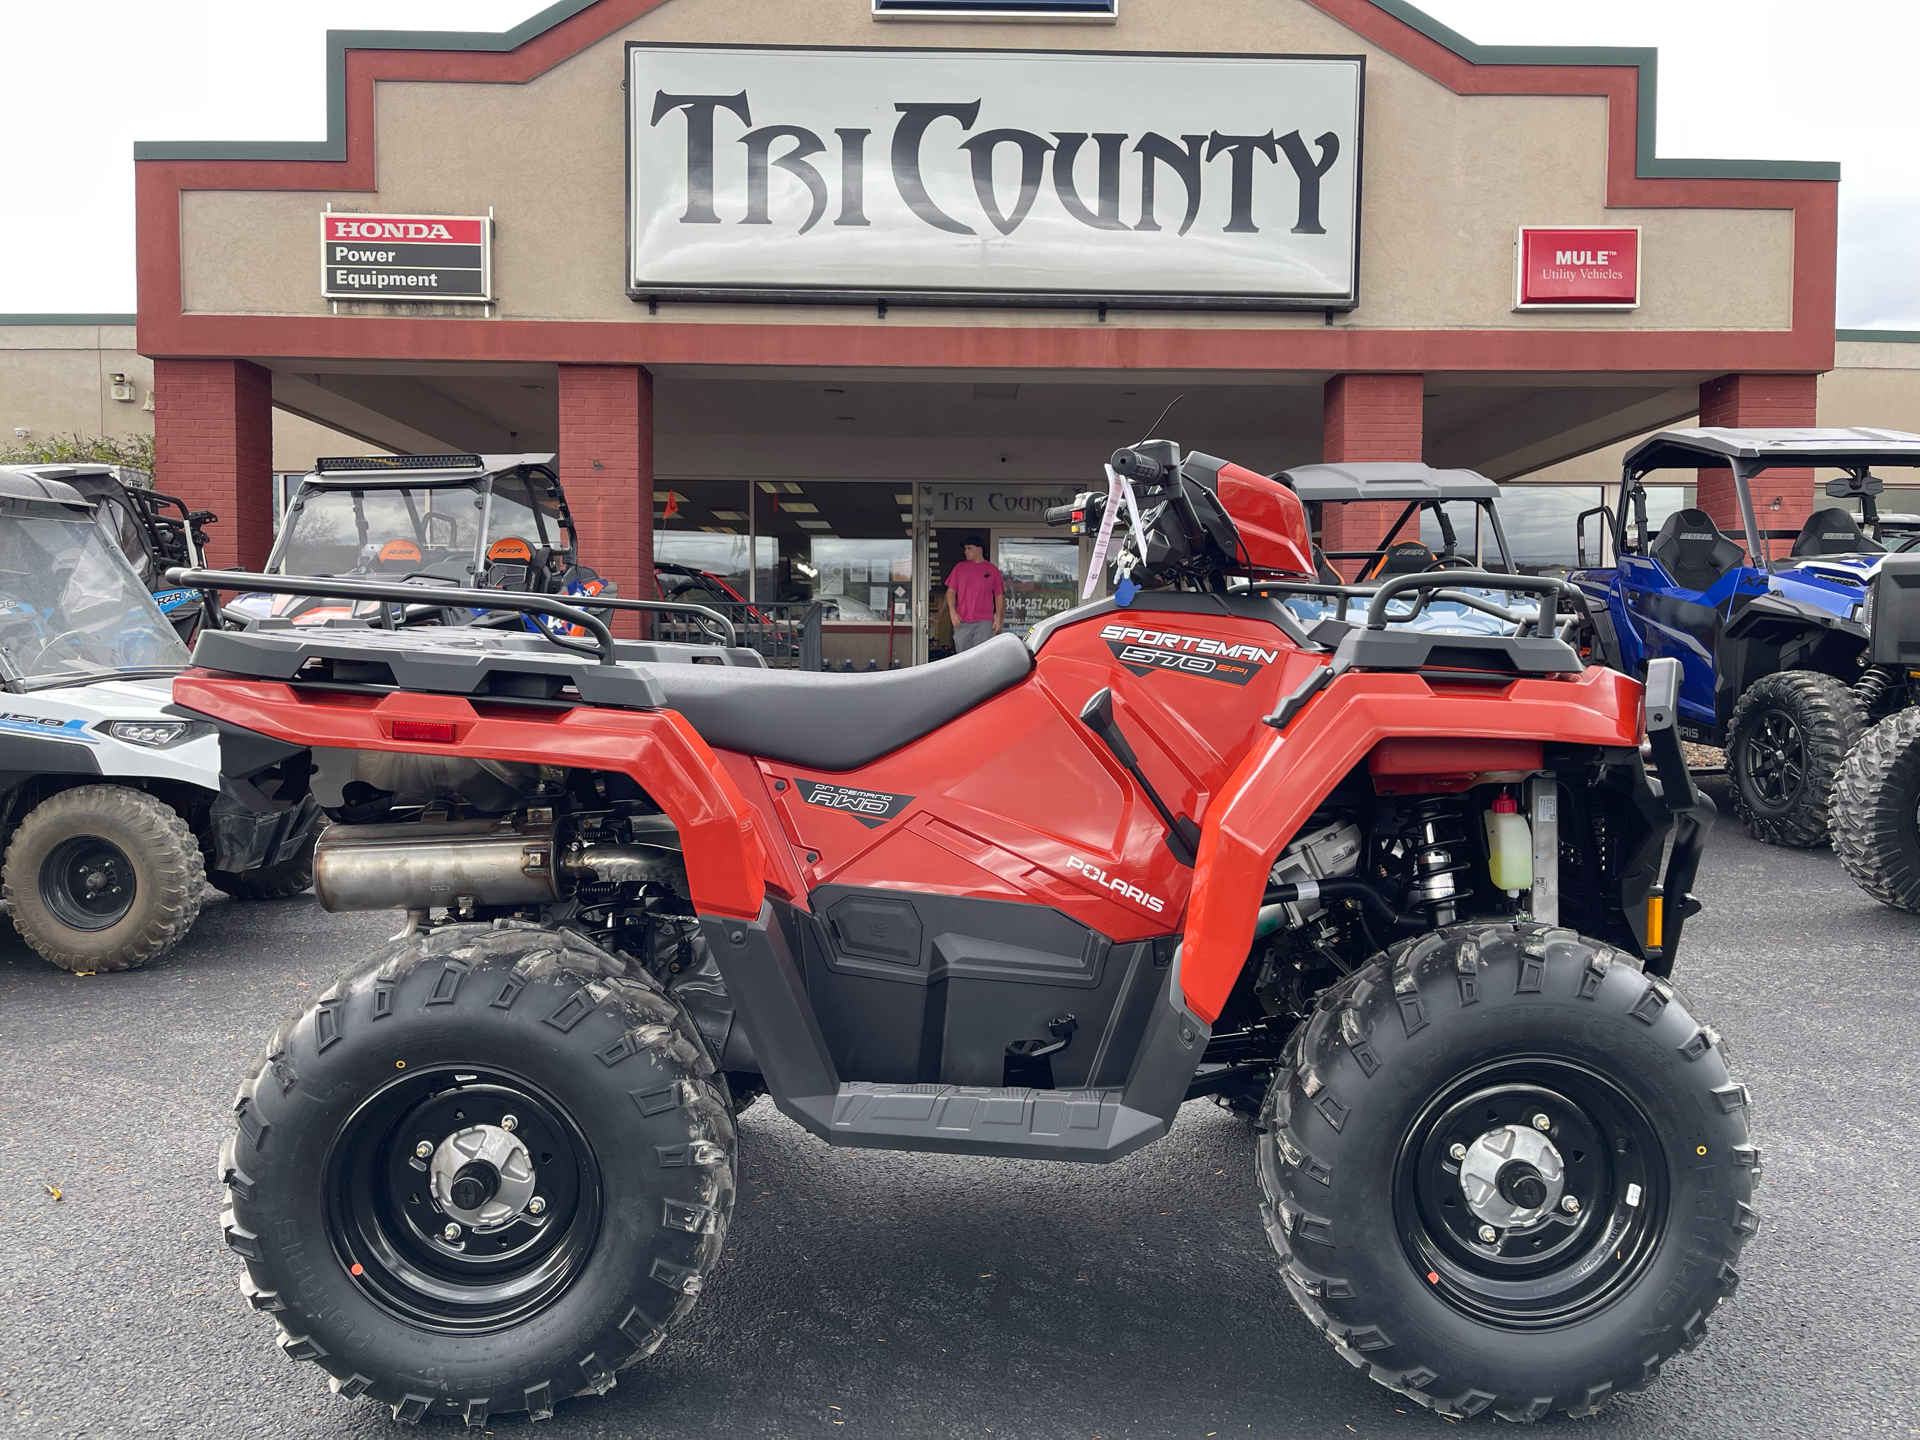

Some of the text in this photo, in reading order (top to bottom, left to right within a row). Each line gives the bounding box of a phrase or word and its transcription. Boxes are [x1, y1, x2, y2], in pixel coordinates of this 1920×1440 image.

[335, 222, 453, 239] HONDA
[335, 247, 396, 262] Power
[336, 270, 438, 289] Equipment
[1542, 269, 1623, 282] Utility Vehicles
[1395, 548, 1426, 556] RZR
[157, 592, 184, 607] RZR
[1005, 598, 1070, 610] 304-257-4420
[1099, 625, 1279, 665] SPORTSMAN
[1119, 645, 1249, 676] 570 EFI
[814, 784, 894, 802] ON DEMAND
[807, 790, 890, 815] AWD
[1065, 855, 1166, 914] POLARIS
